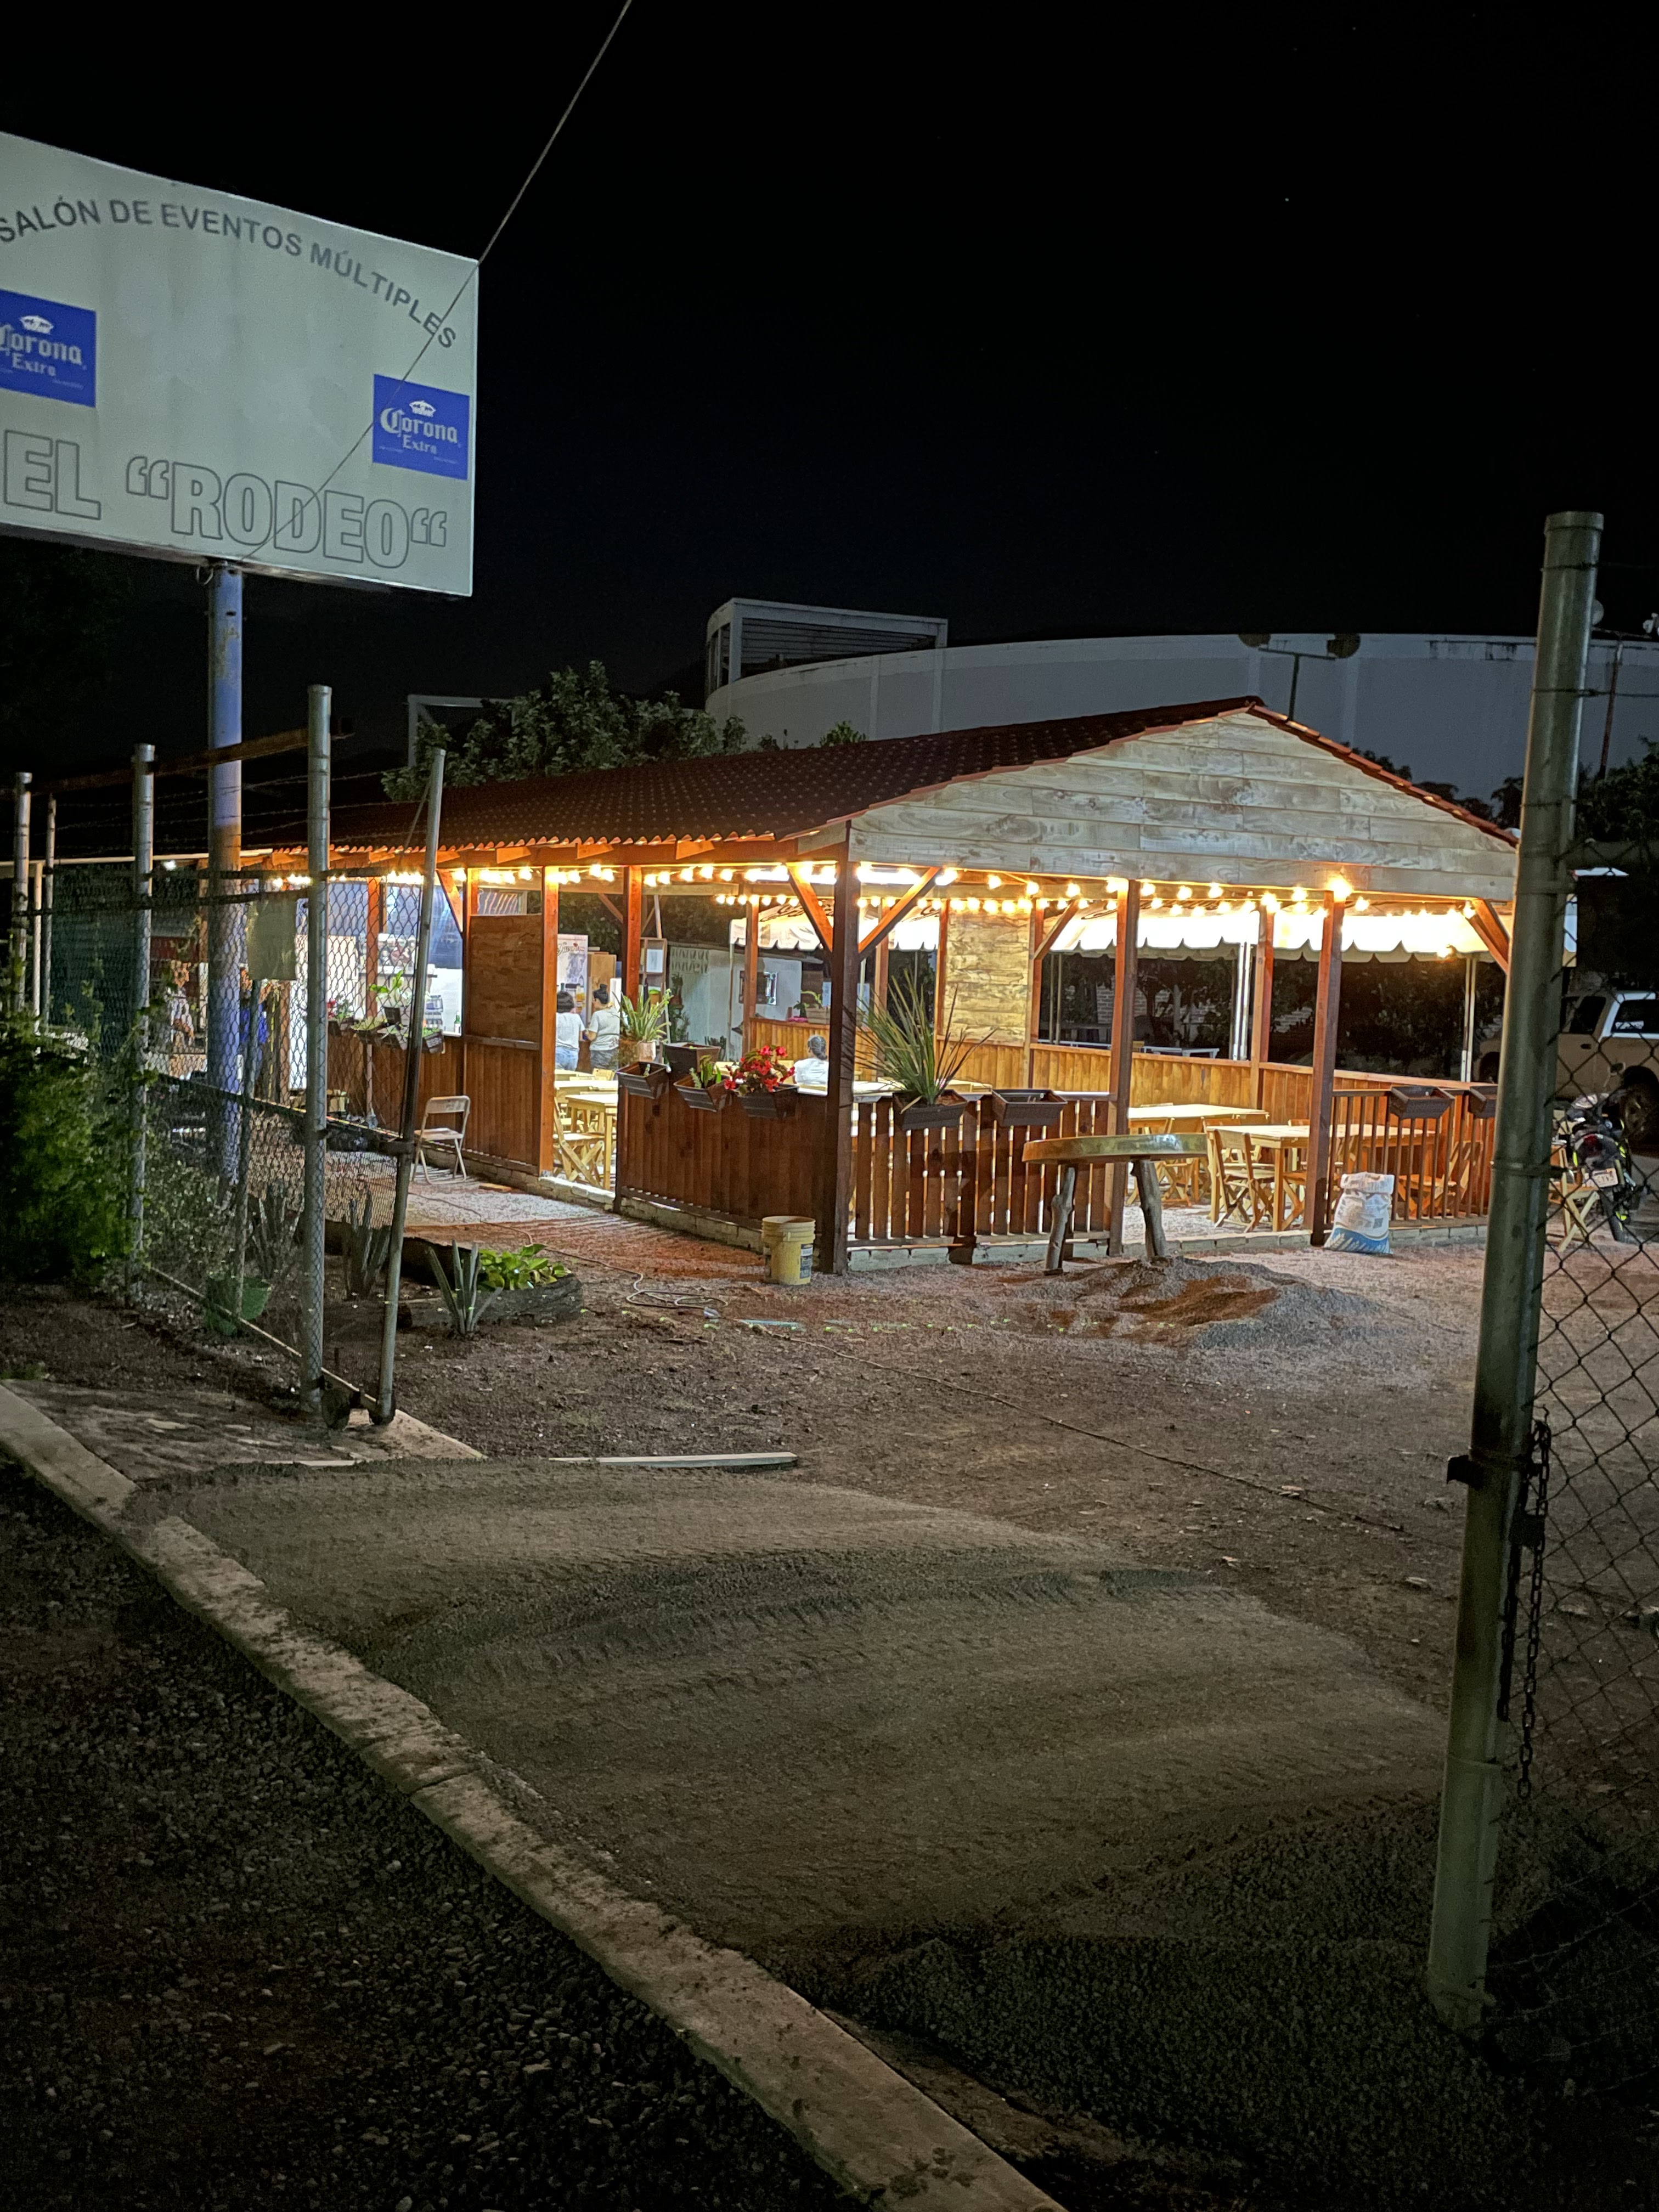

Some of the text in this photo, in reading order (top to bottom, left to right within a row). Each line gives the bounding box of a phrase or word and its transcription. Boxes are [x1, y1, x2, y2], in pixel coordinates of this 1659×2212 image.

[0, 194, 456, 348] SALÓN DE EVENTOS MÚLTIPLES
[12, 352, 57, 377] Extra
[380, 407, 459, 444] Corona
[402, 433, 438, 455] Extra
[3, 429, 102, 521] EL
